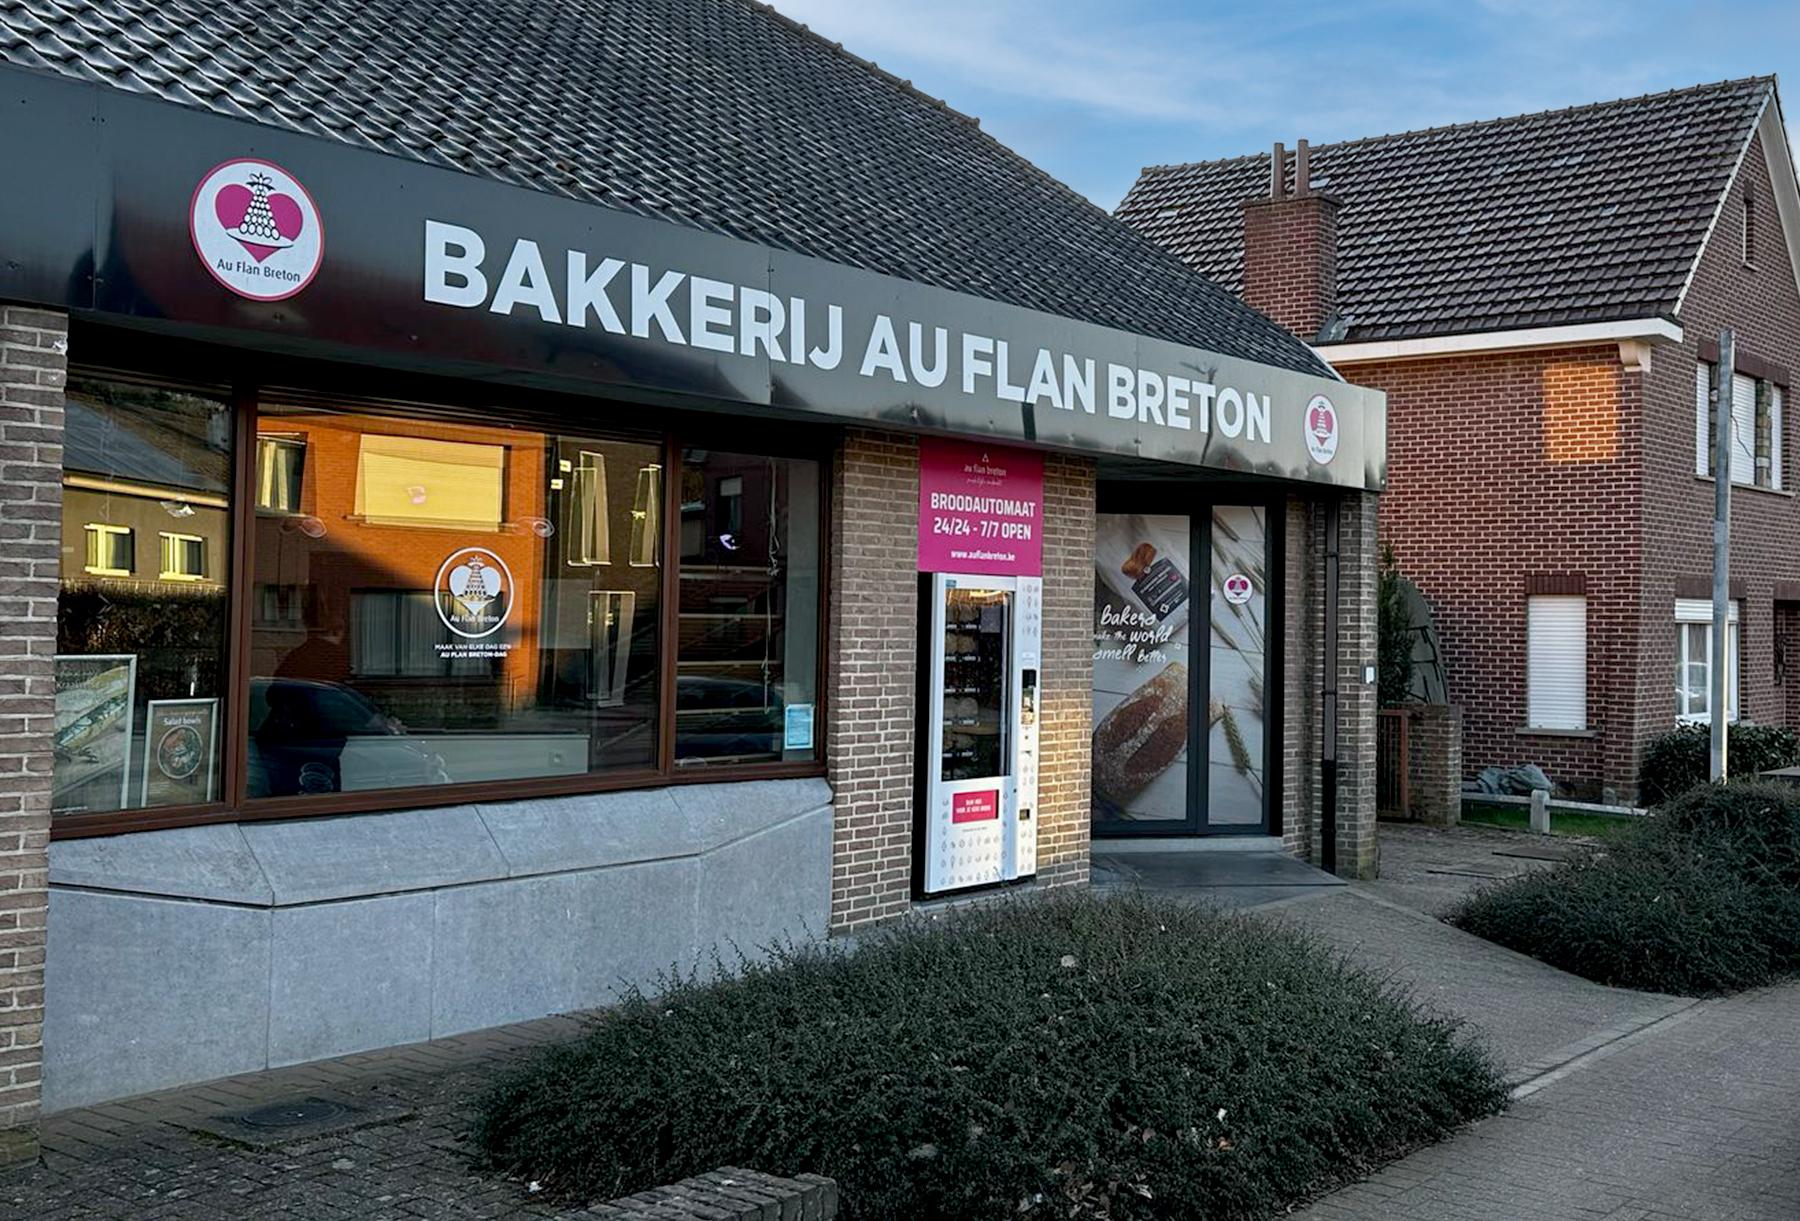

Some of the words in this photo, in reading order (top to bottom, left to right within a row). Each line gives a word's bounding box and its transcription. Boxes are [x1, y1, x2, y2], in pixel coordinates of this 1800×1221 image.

[217, 258, 233, 271] Au
[236, 261, 260, 275] Flan
[263, 266, 300, 282] Breton
[424, 219, 843, 371] BAKKERIJ
[859, 314, 949, 388] AU
[962, 333, 1096, 415] FLAN
[1107, 362, 1271, 444] BRETON
[931, 492, 1036, 518] BROODAUTOMAAT
[934, 517, 970, 536] 24/24
[980, 521, 999, 538] 7/7
[1001, 522, 1031, 540] OPEN
[951, 550, 1016, 561] www.auflanbreton.be
[1101, 604, 1157, 627] bakers
[1130, 625, 1174, 645] world
[1137, 649, 1167, 664] better
